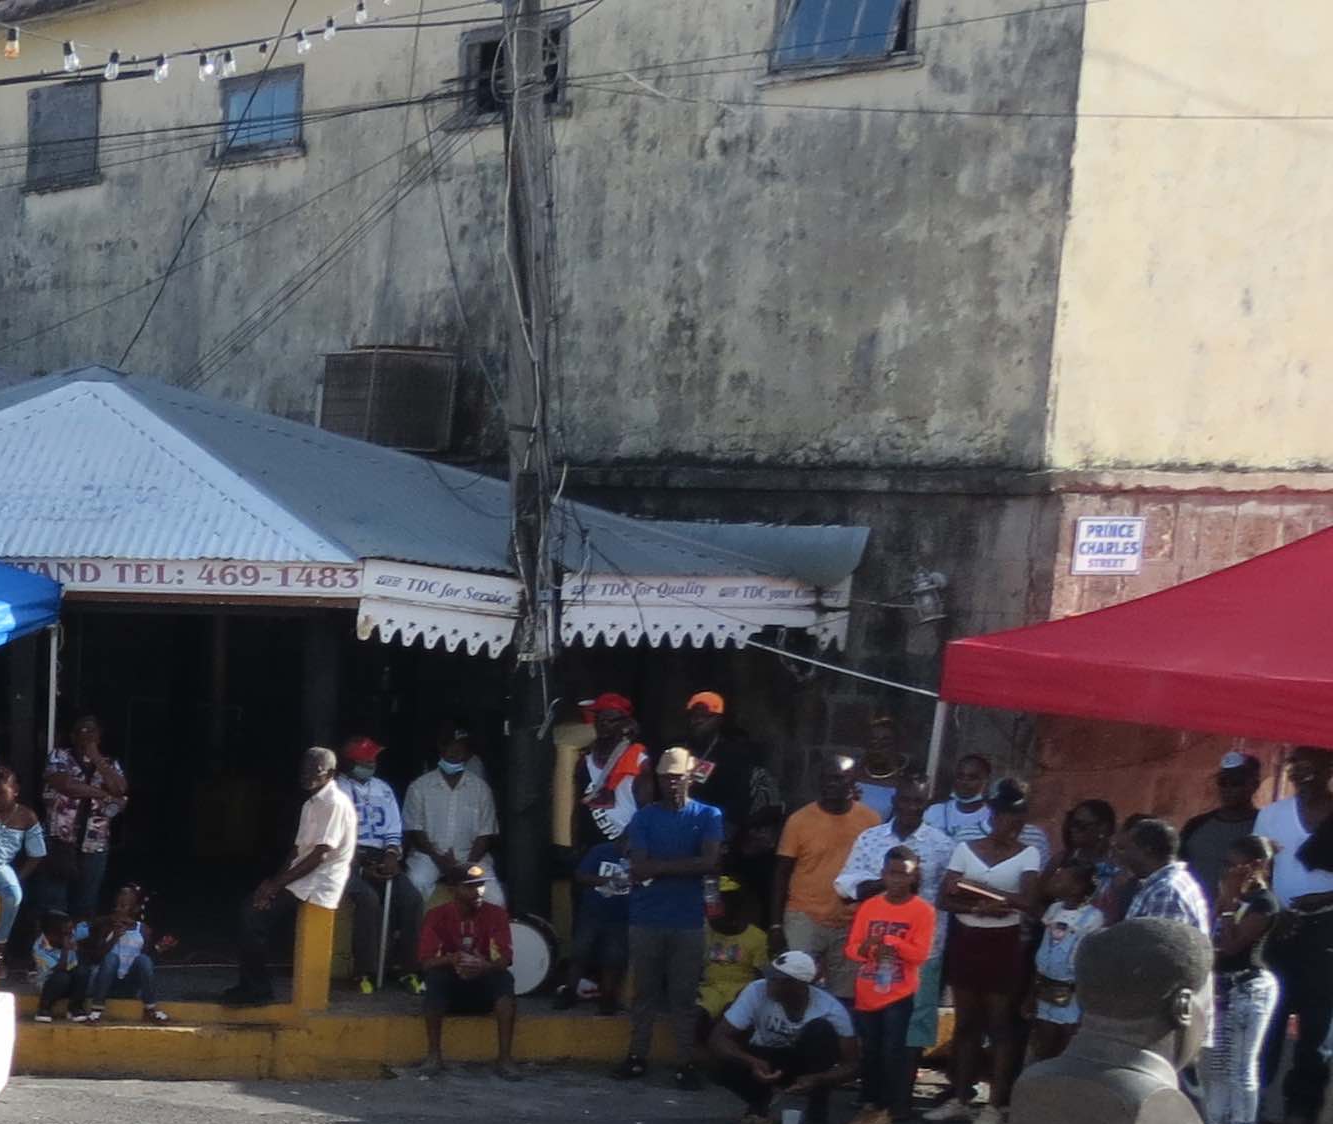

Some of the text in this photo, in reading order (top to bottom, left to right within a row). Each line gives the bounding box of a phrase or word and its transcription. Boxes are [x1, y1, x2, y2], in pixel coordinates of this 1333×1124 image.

[1085, 524, 1135, 538] PRINCE
[1079, 541, 1140, 556] CHARLES
[1087, 558, 1127, 568] STREET
[113, 563, 185, 585] TEL:
[196, 563, 359, 589] 469-1483
[406, 577, 440, 594] TDC
[437, 582, 462, 599] for
[465, 586, 513, 605] Service
[600, 583, 632, 596] TDC
[657, 582, 707, 599] Quality
[742, 585, 766, 599] TDC
